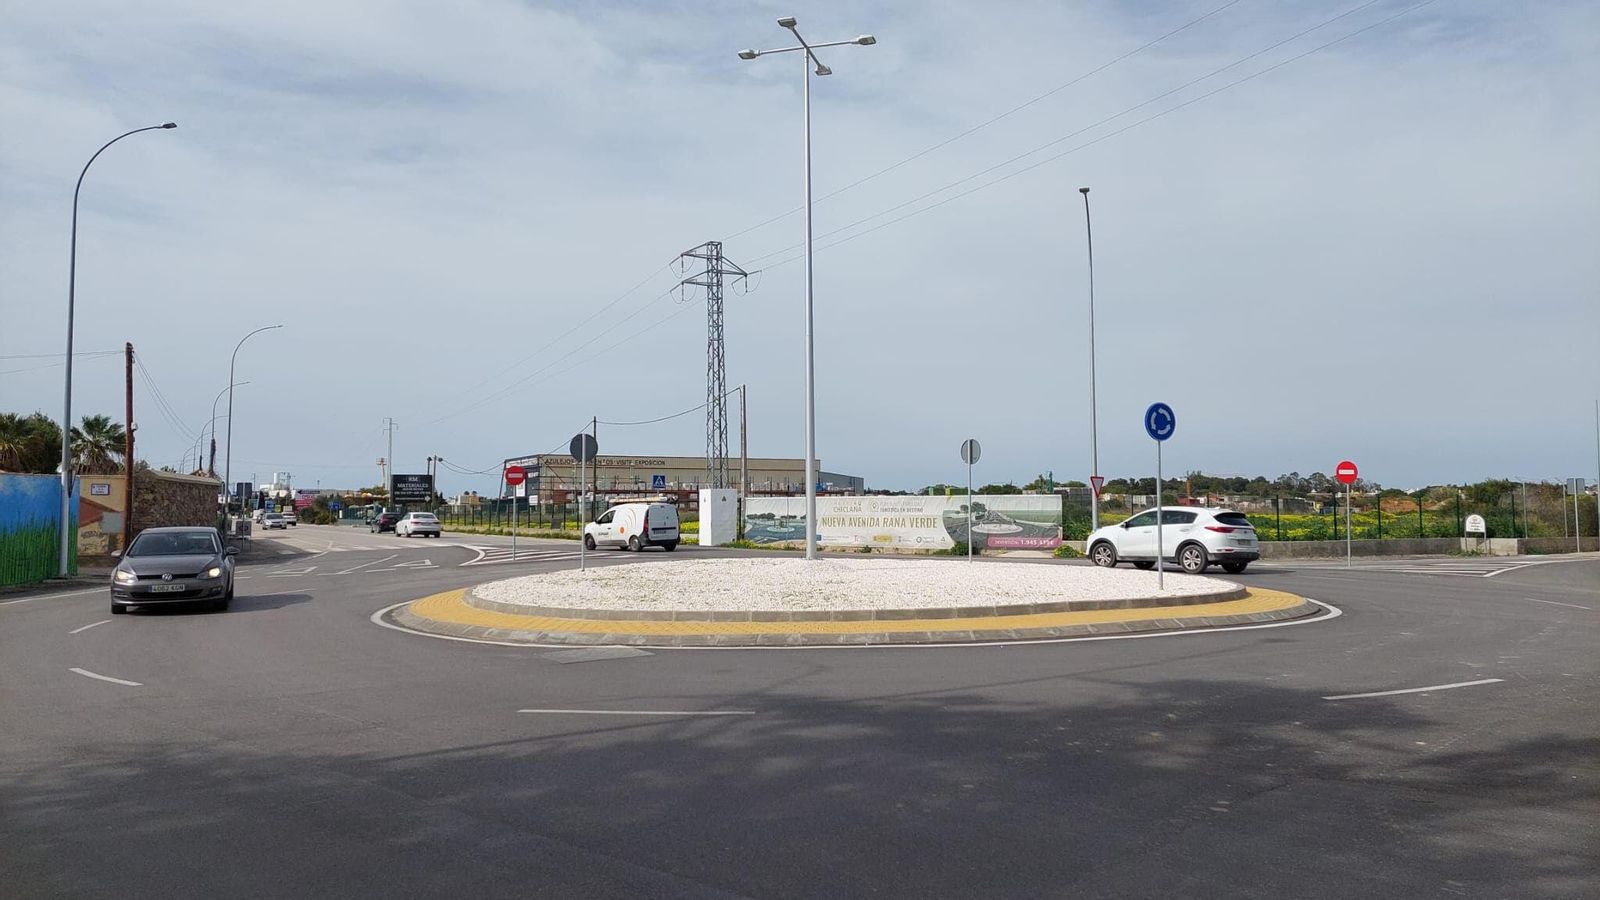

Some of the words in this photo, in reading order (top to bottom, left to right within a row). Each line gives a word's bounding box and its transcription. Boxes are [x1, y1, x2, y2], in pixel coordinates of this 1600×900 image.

[822, 517, 846, 528] NUEVA
[848, 517, 880, 528] AVENIDA
[883, 517, 906, 528] RANA
[909, 517, 938, 529] VERDE
